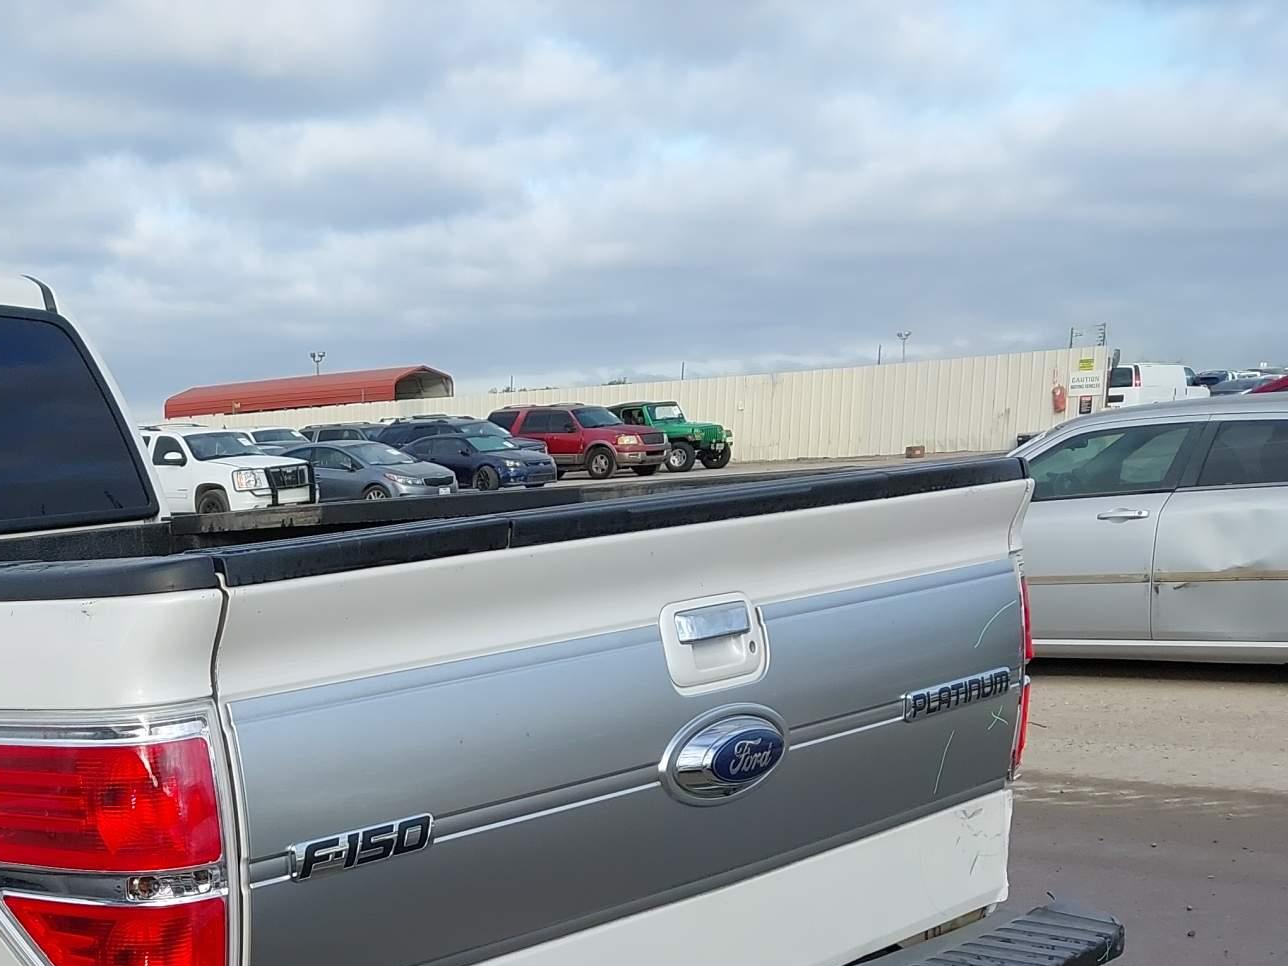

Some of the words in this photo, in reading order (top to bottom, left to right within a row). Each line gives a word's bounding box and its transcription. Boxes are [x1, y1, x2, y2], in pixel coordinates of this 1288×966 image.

[1071, 375, 1100, 383] CAUTION
[912, 670, 1010, 718] PLATINUM
[729, 738, 774, 776] Ford
[296, 813, 434, 881] F-150
